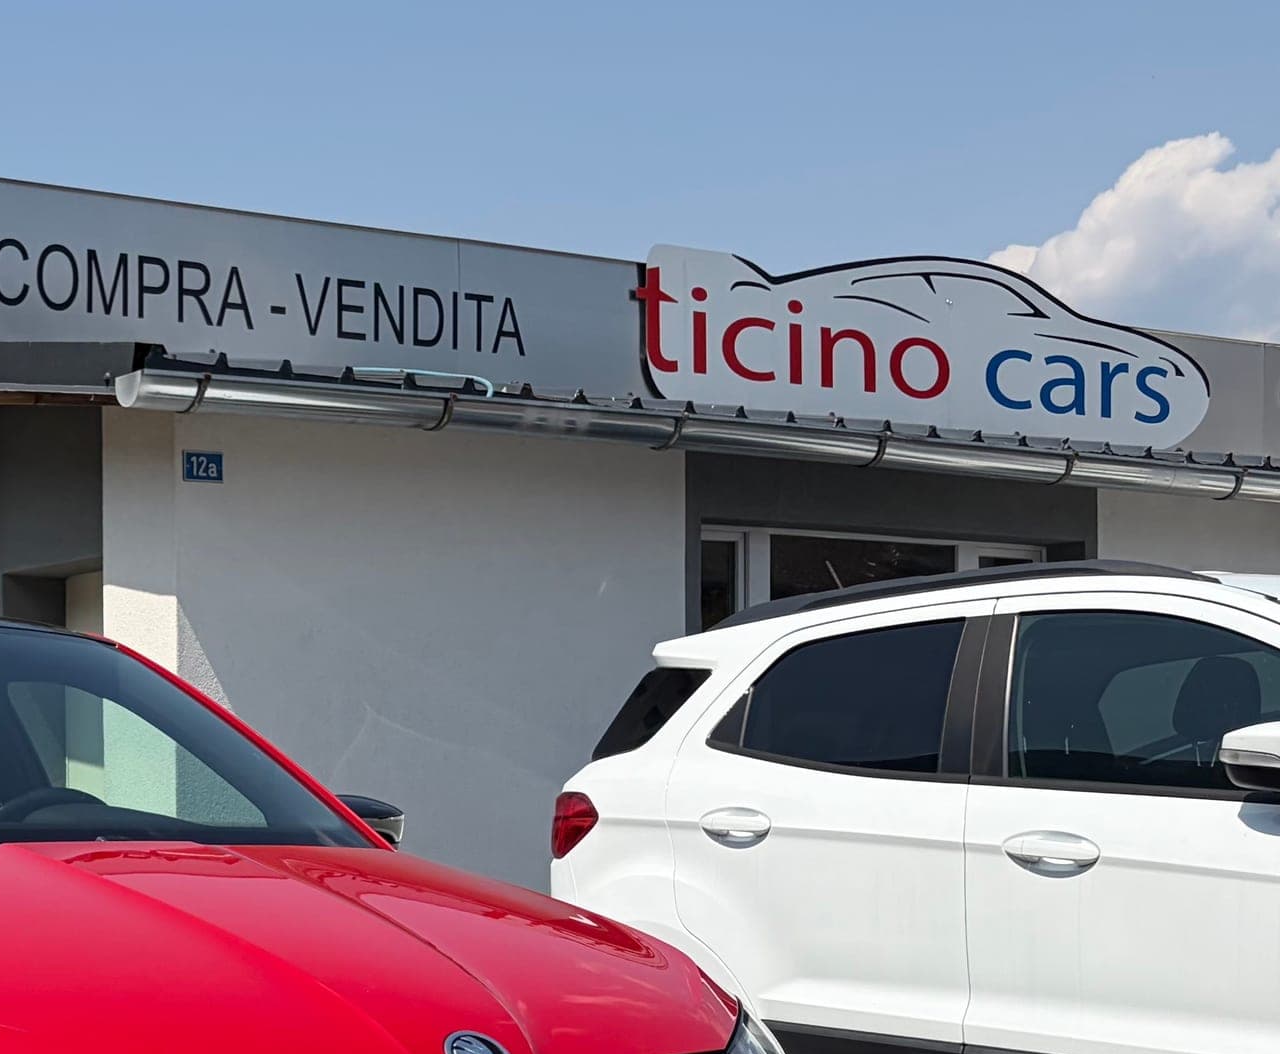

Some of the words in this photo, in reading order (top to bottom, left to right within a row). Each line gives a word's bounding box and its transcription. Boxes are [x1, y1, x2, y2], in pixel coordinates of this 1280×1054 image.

[295, 273, 526, 356] VENDITA
[636, 266, 951, 400] ticino
[985, 348, 1172, 425] cars
[190, 455, 218, 477] 12a
